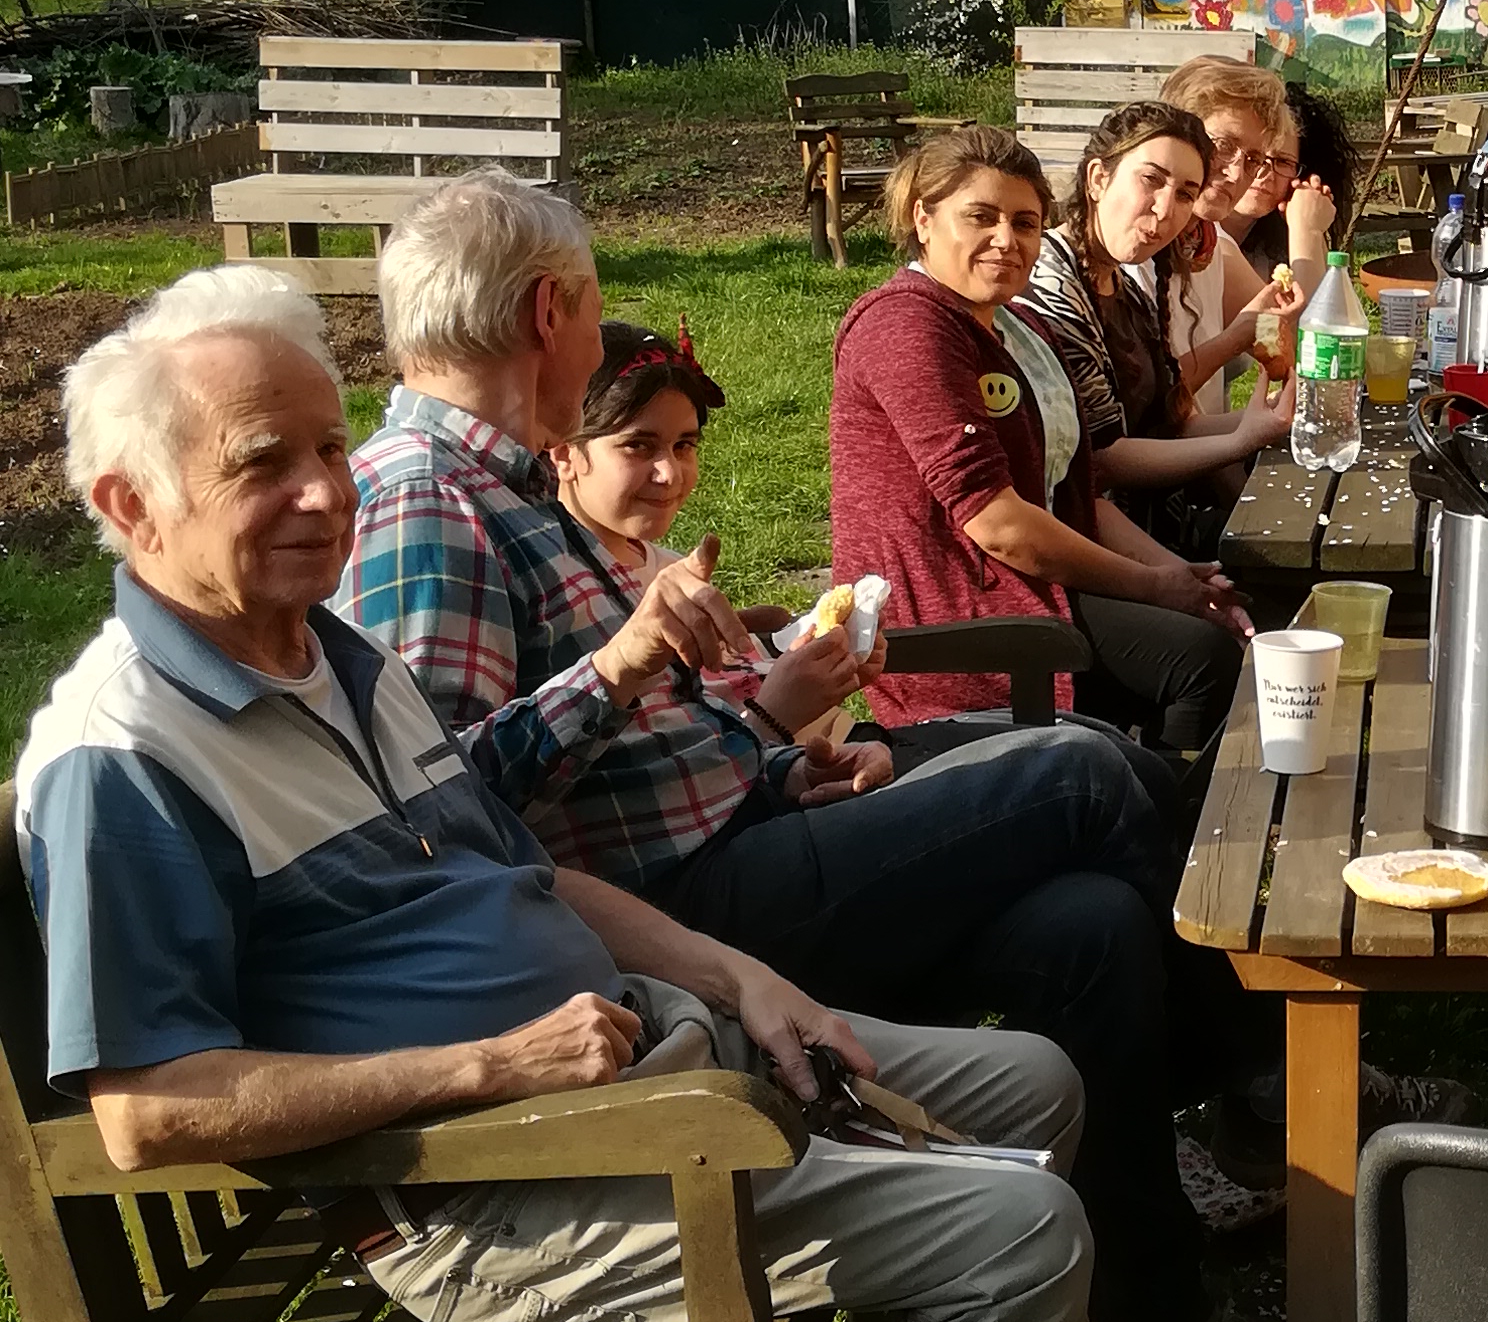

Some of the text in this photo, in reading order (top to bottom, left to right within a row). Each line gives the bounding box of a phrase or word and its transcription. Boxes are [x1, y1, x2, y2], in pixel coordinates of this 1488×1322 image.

[1263, 678, 1327, 694] Nur wer sich
